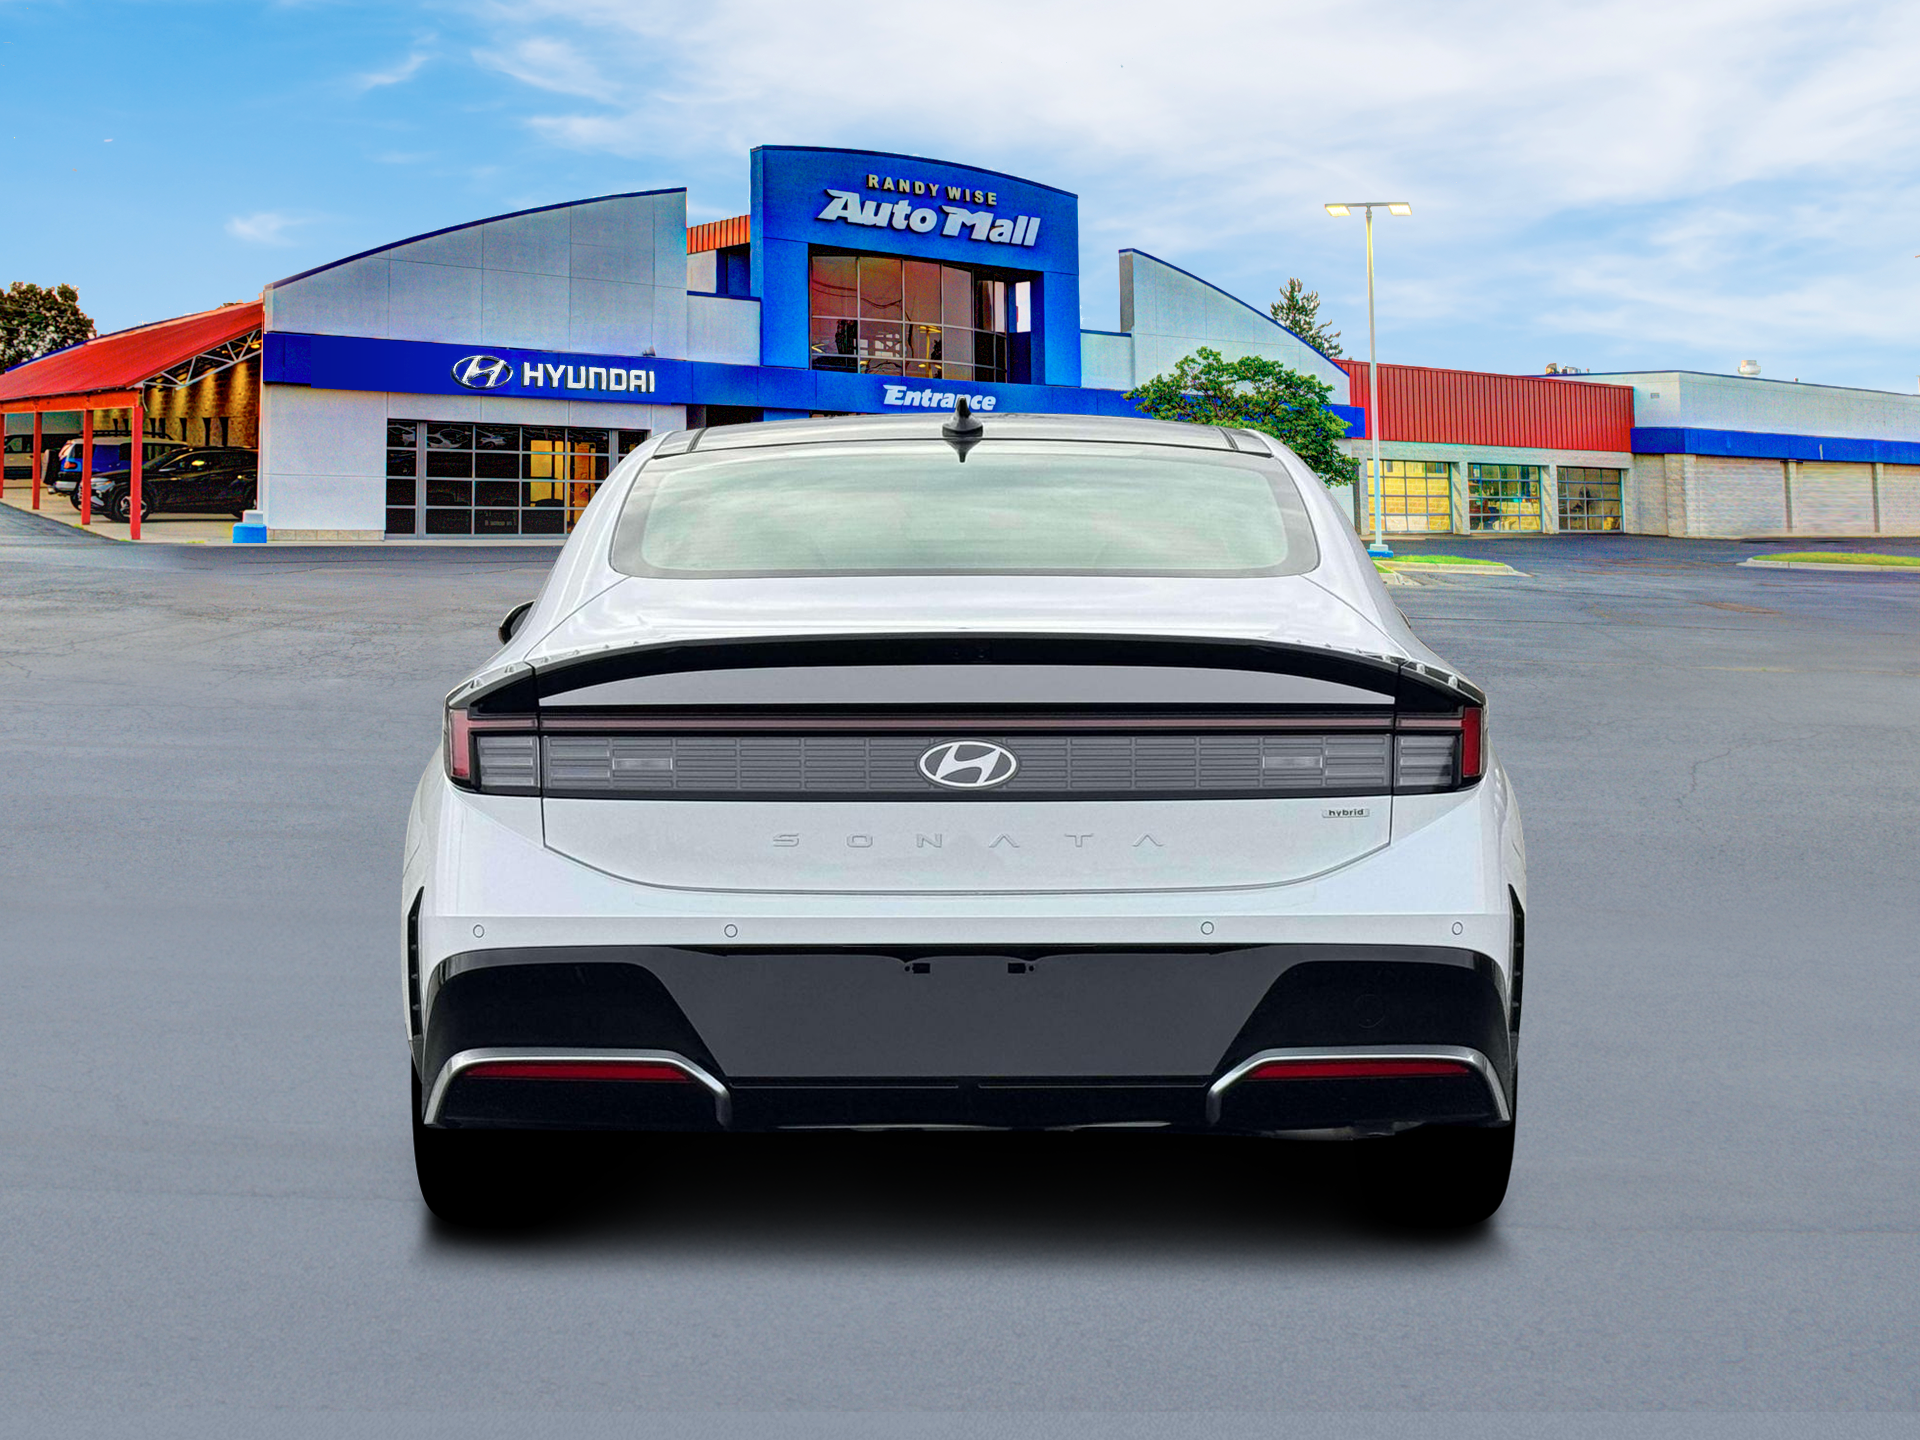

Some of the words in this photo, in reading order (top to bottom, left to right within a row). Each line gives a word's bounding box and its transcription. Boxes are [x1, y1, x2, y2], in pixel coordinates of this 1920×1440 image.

[867, 174, 939, 197] RANDY
[946, 186, 998, 206] WISE
[816, 188, 938, 233] Auto
[941, 204, 1042, 247] Mall
[522, 361, 656, 393] HYUNDAI
[1328, 808, 1364, 817] hybrid
[772, 832, 1165, 848] SONATA
